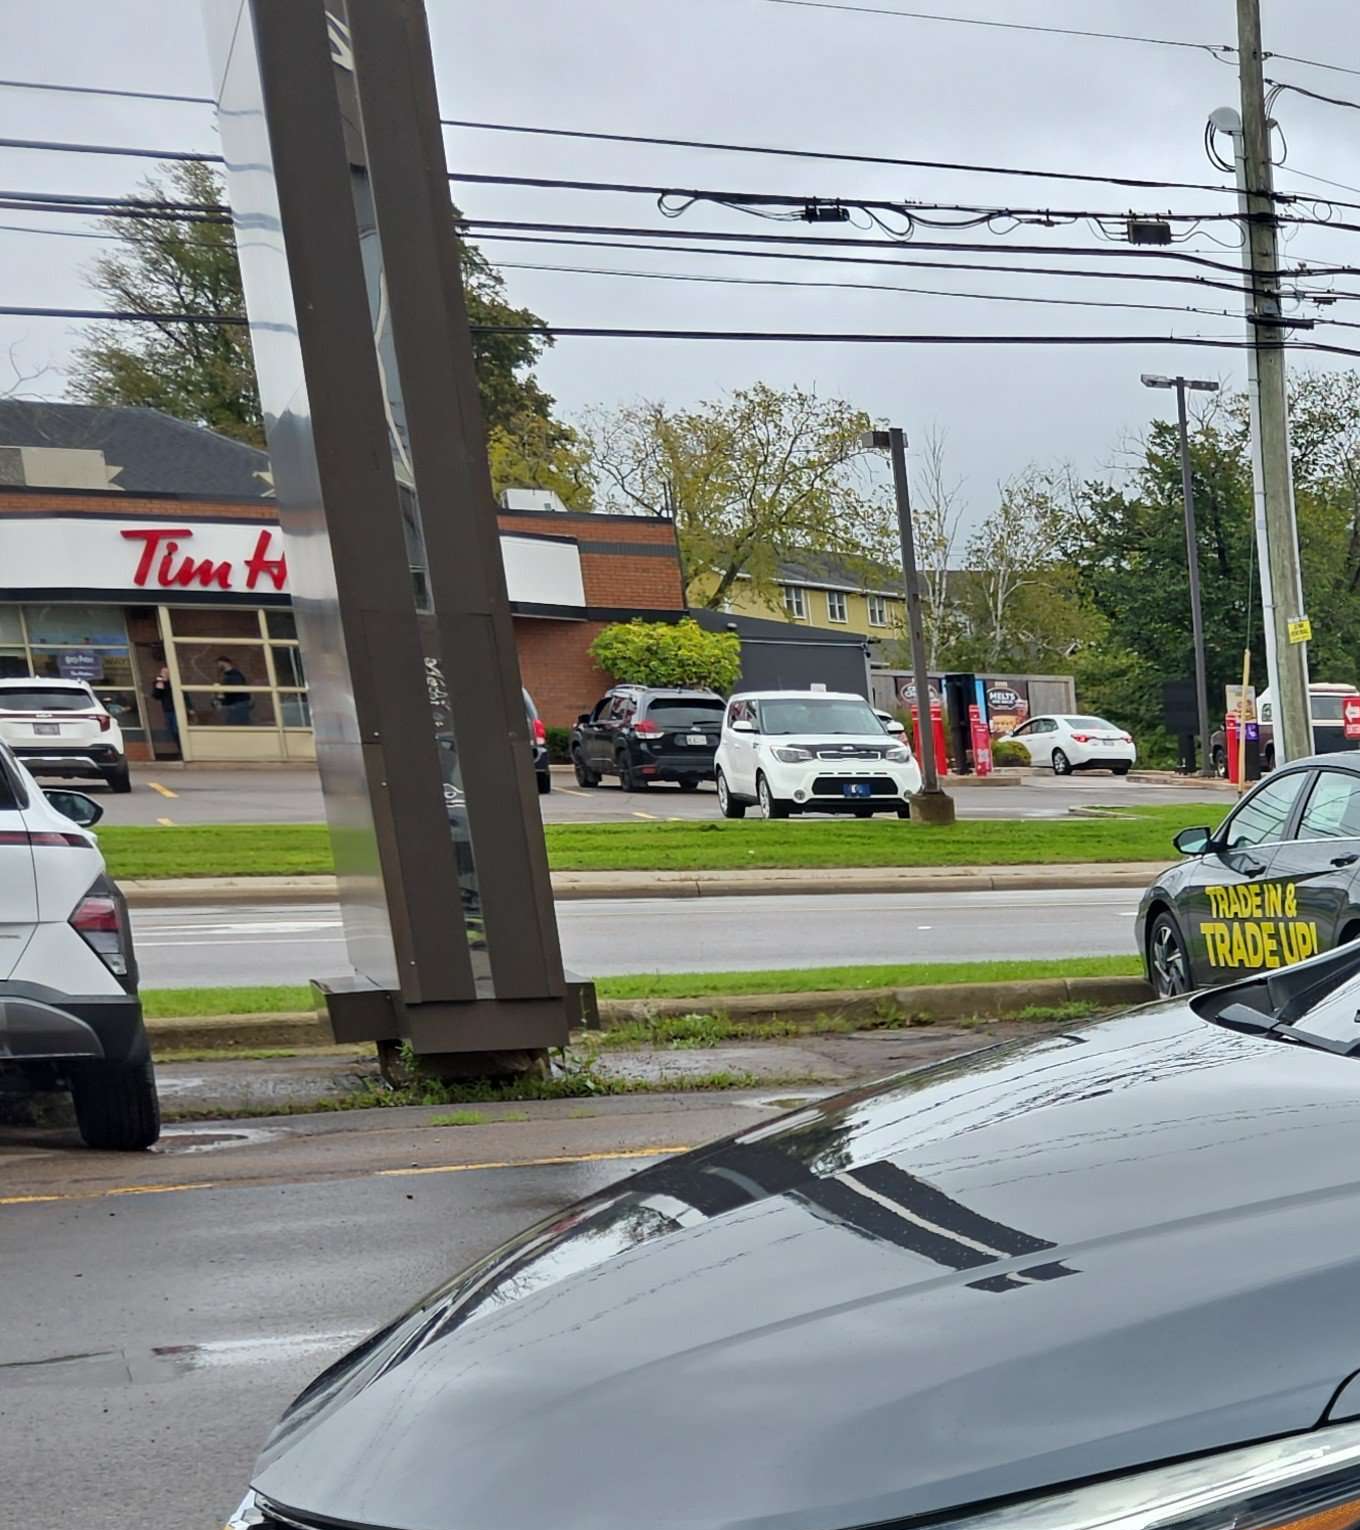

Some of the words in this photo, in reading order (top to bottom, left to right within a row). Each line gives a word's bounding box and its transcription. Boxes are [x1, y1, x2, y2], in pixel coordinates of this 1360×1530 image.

[120, 529, 232, 589] Tim
[1205, 884, 1262, 918] TRADE
[1263, 883, 1282, 917] IN
[1284, 882, 1296, 917] &
[1200, 922, 1280, 968] TRADE
[1278, 922, 1318, 965] UP!
